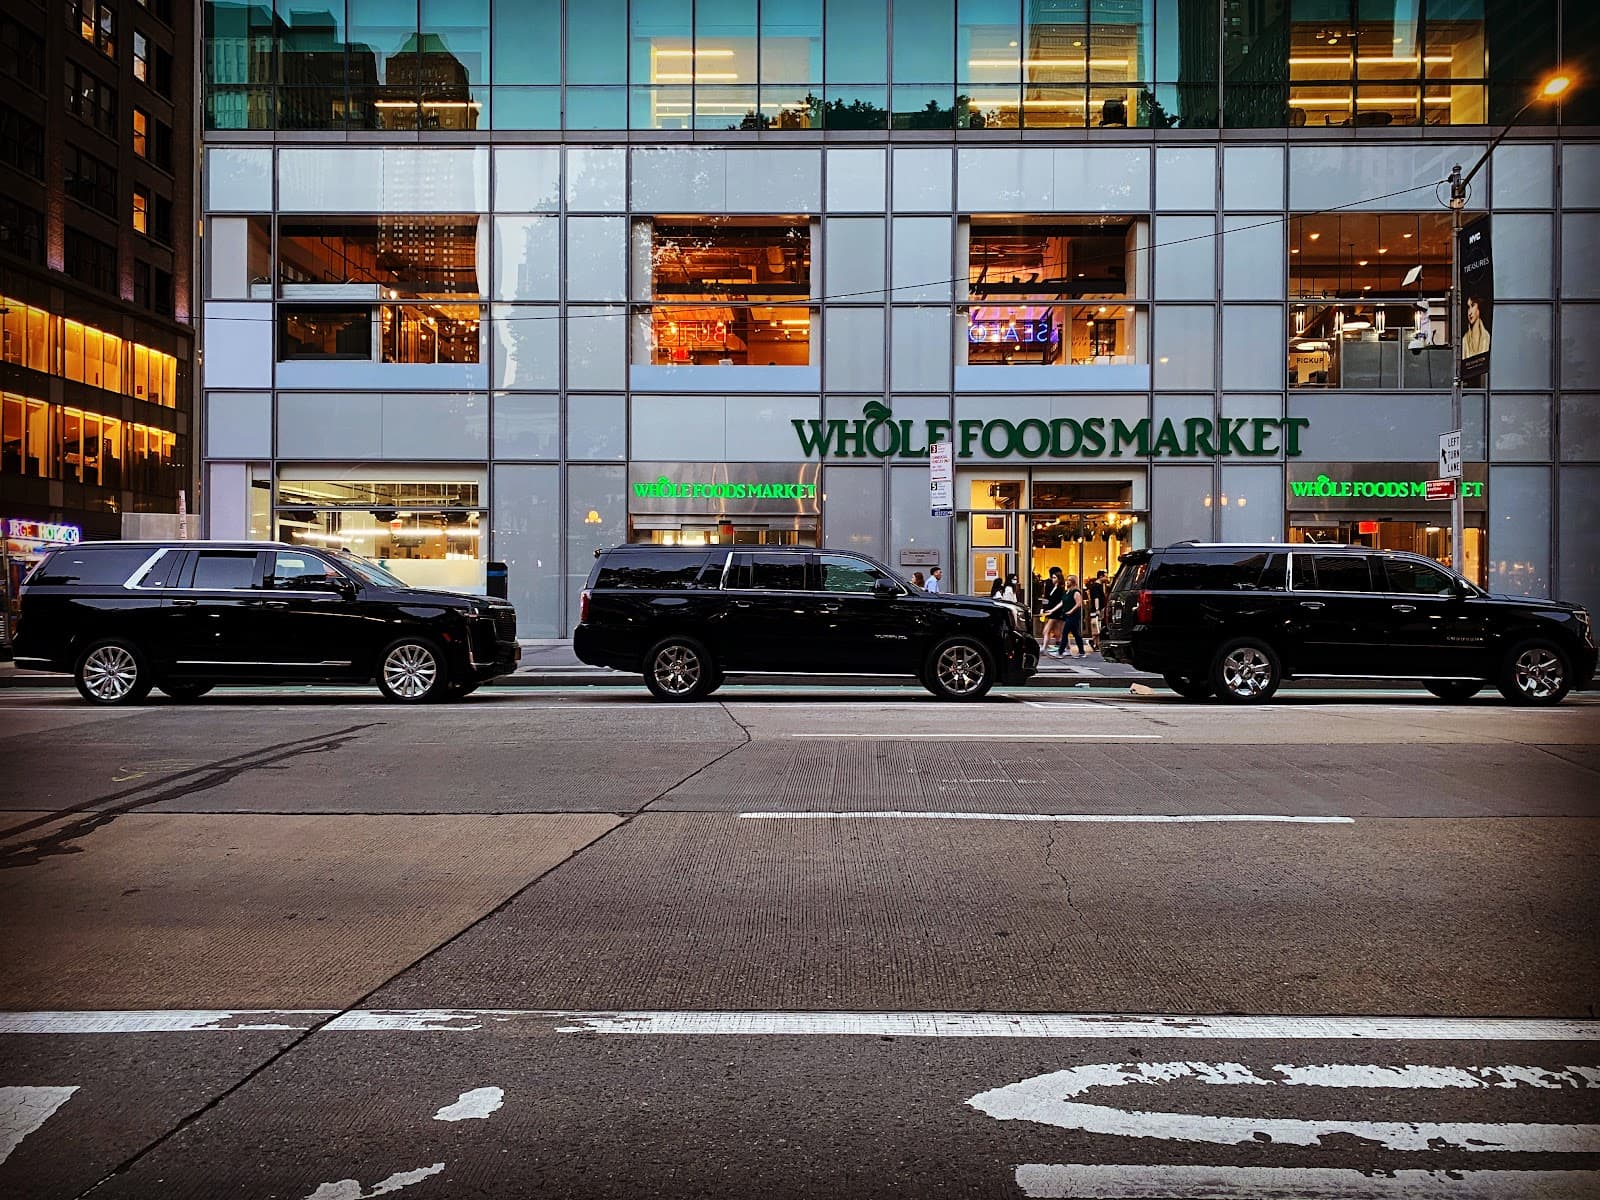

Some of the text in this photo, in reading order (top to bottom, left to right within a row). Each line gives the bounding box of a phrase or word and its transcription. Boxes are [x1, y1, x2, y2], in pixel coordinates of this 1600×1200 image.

[1469, 232, 1481, 245] NYC
[790, 409, 1310, 458] WHOLE FOODS MARKET
[1447, 437, 1460, 448] LEFT
[1447, 449, 1460, 460] TURN
[1447, 462, 1460, 473] LANE
[632, 479, 817, 499] WHOLE FOODS MARKET
[1290, 478, 1484, 498] WHOLE FOODS MET
